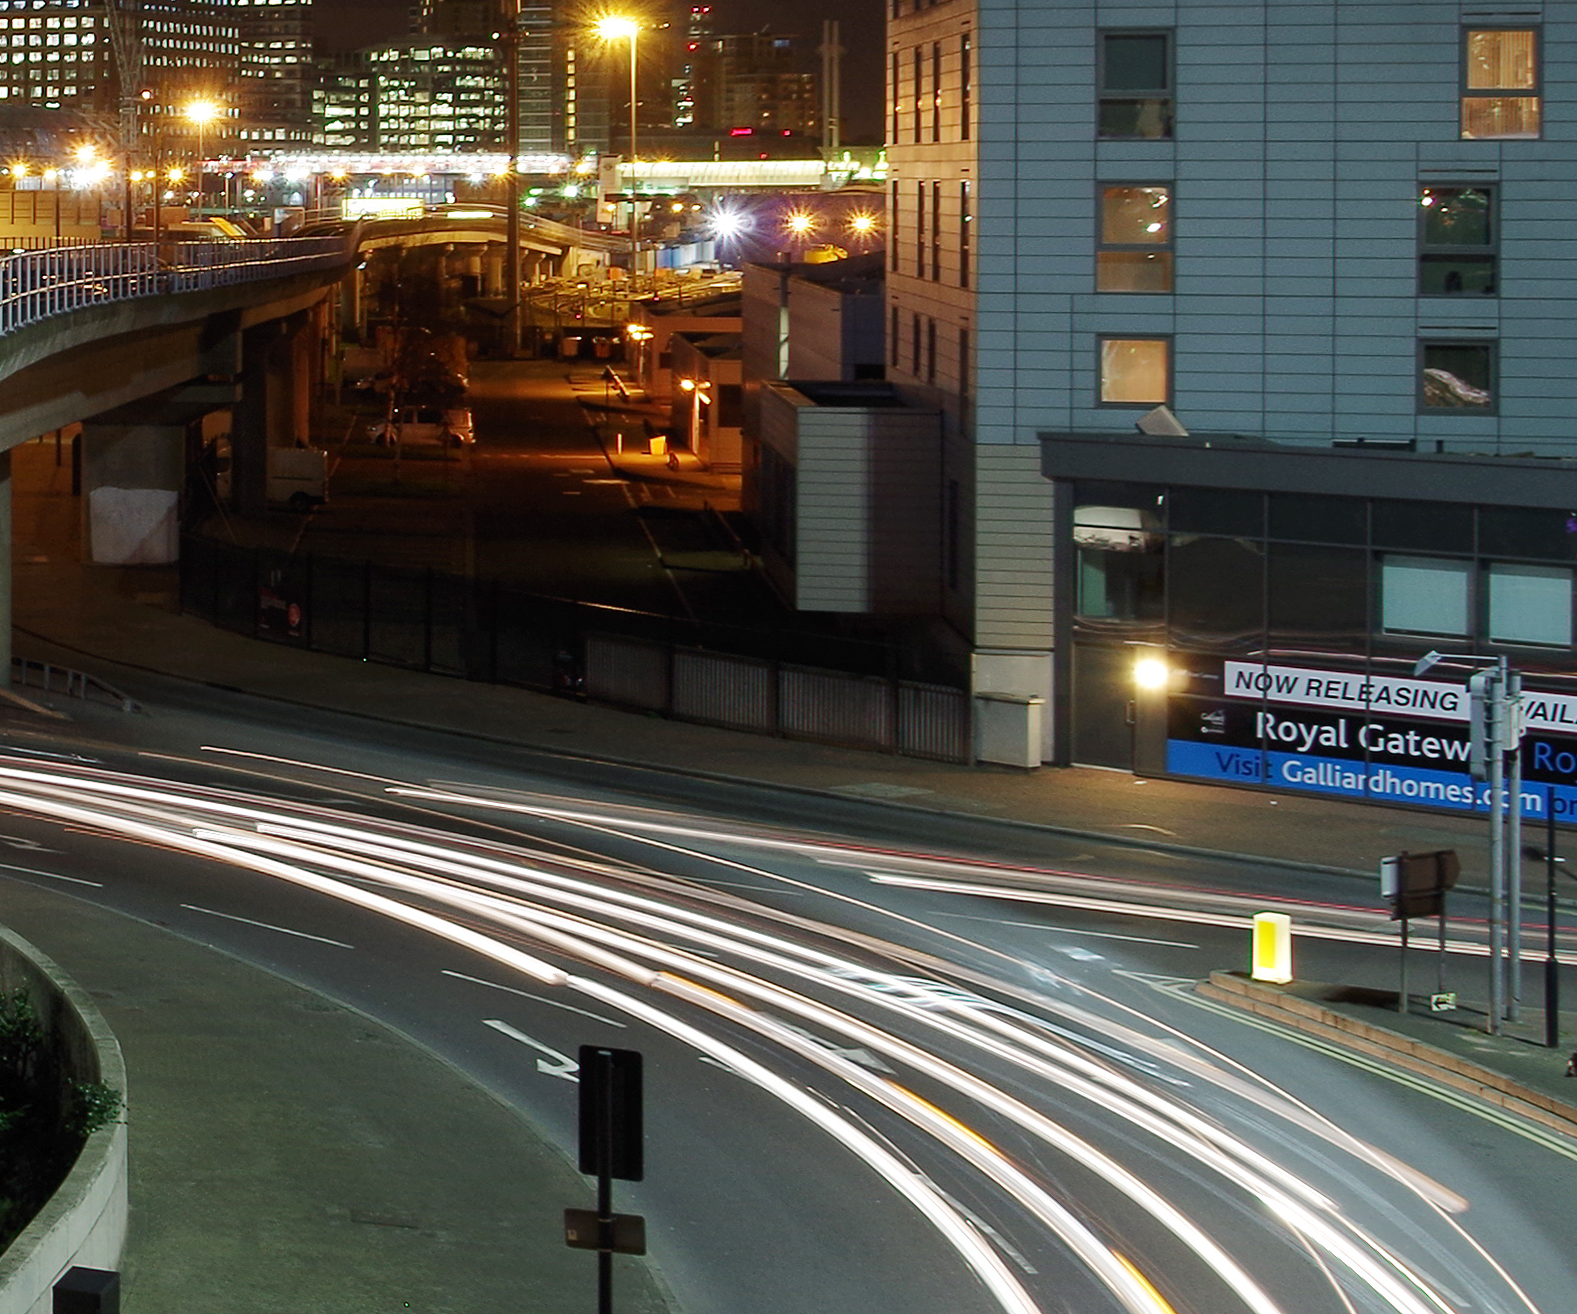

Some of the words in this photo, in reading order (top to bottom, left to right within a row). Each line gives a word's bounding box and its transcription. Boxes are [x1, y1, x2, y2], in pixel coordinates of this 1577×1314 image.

[1234, 670, 1300, 695] NOW
[1304, 678, 1460, 712] RELEASING
[1215, 751, 1273, 779] Visit
[1256, 710, 1349, 753] Royal
[1358, 723, 1472, 762] Gatew
[1533, 741, 1577, 784] Ro
